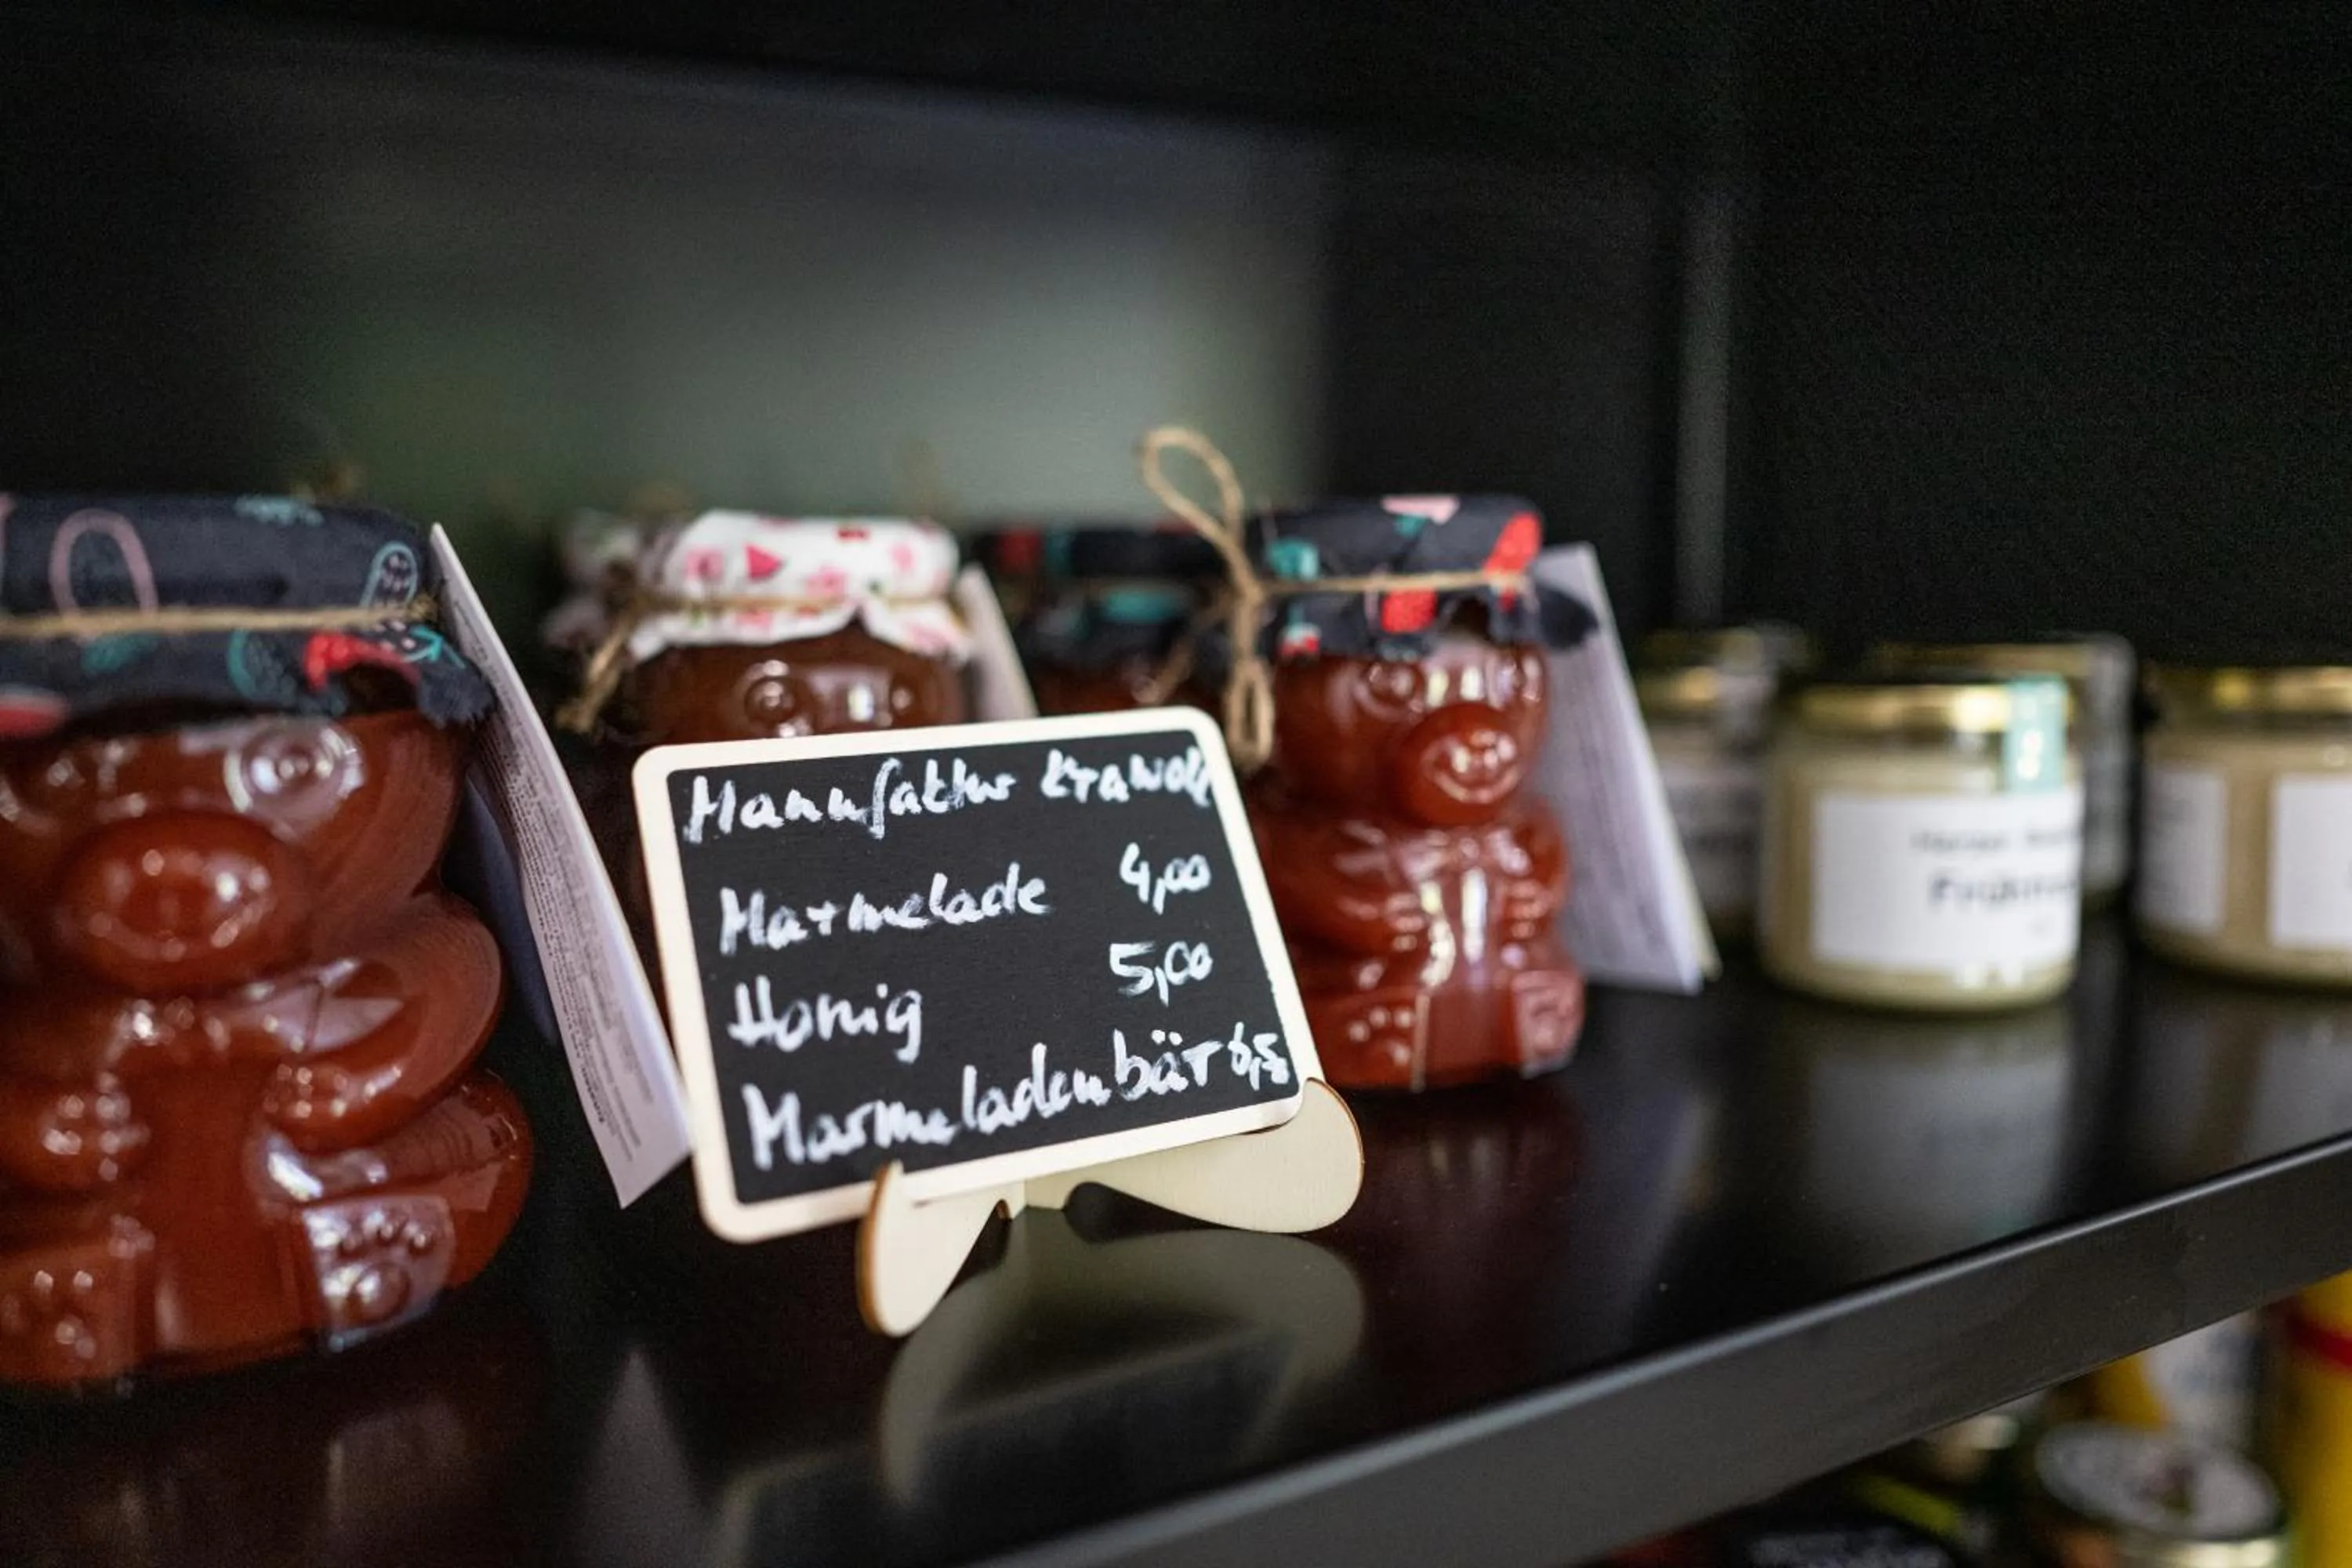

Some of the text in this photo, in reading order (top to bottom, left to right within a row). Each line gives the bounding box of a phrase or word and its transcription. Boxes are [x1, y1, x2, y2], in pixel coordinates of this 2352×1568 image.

[720, 842, 1211, 955] Marmelade 4,00
[728, 941, 1214, 1064] Honig 5,00
